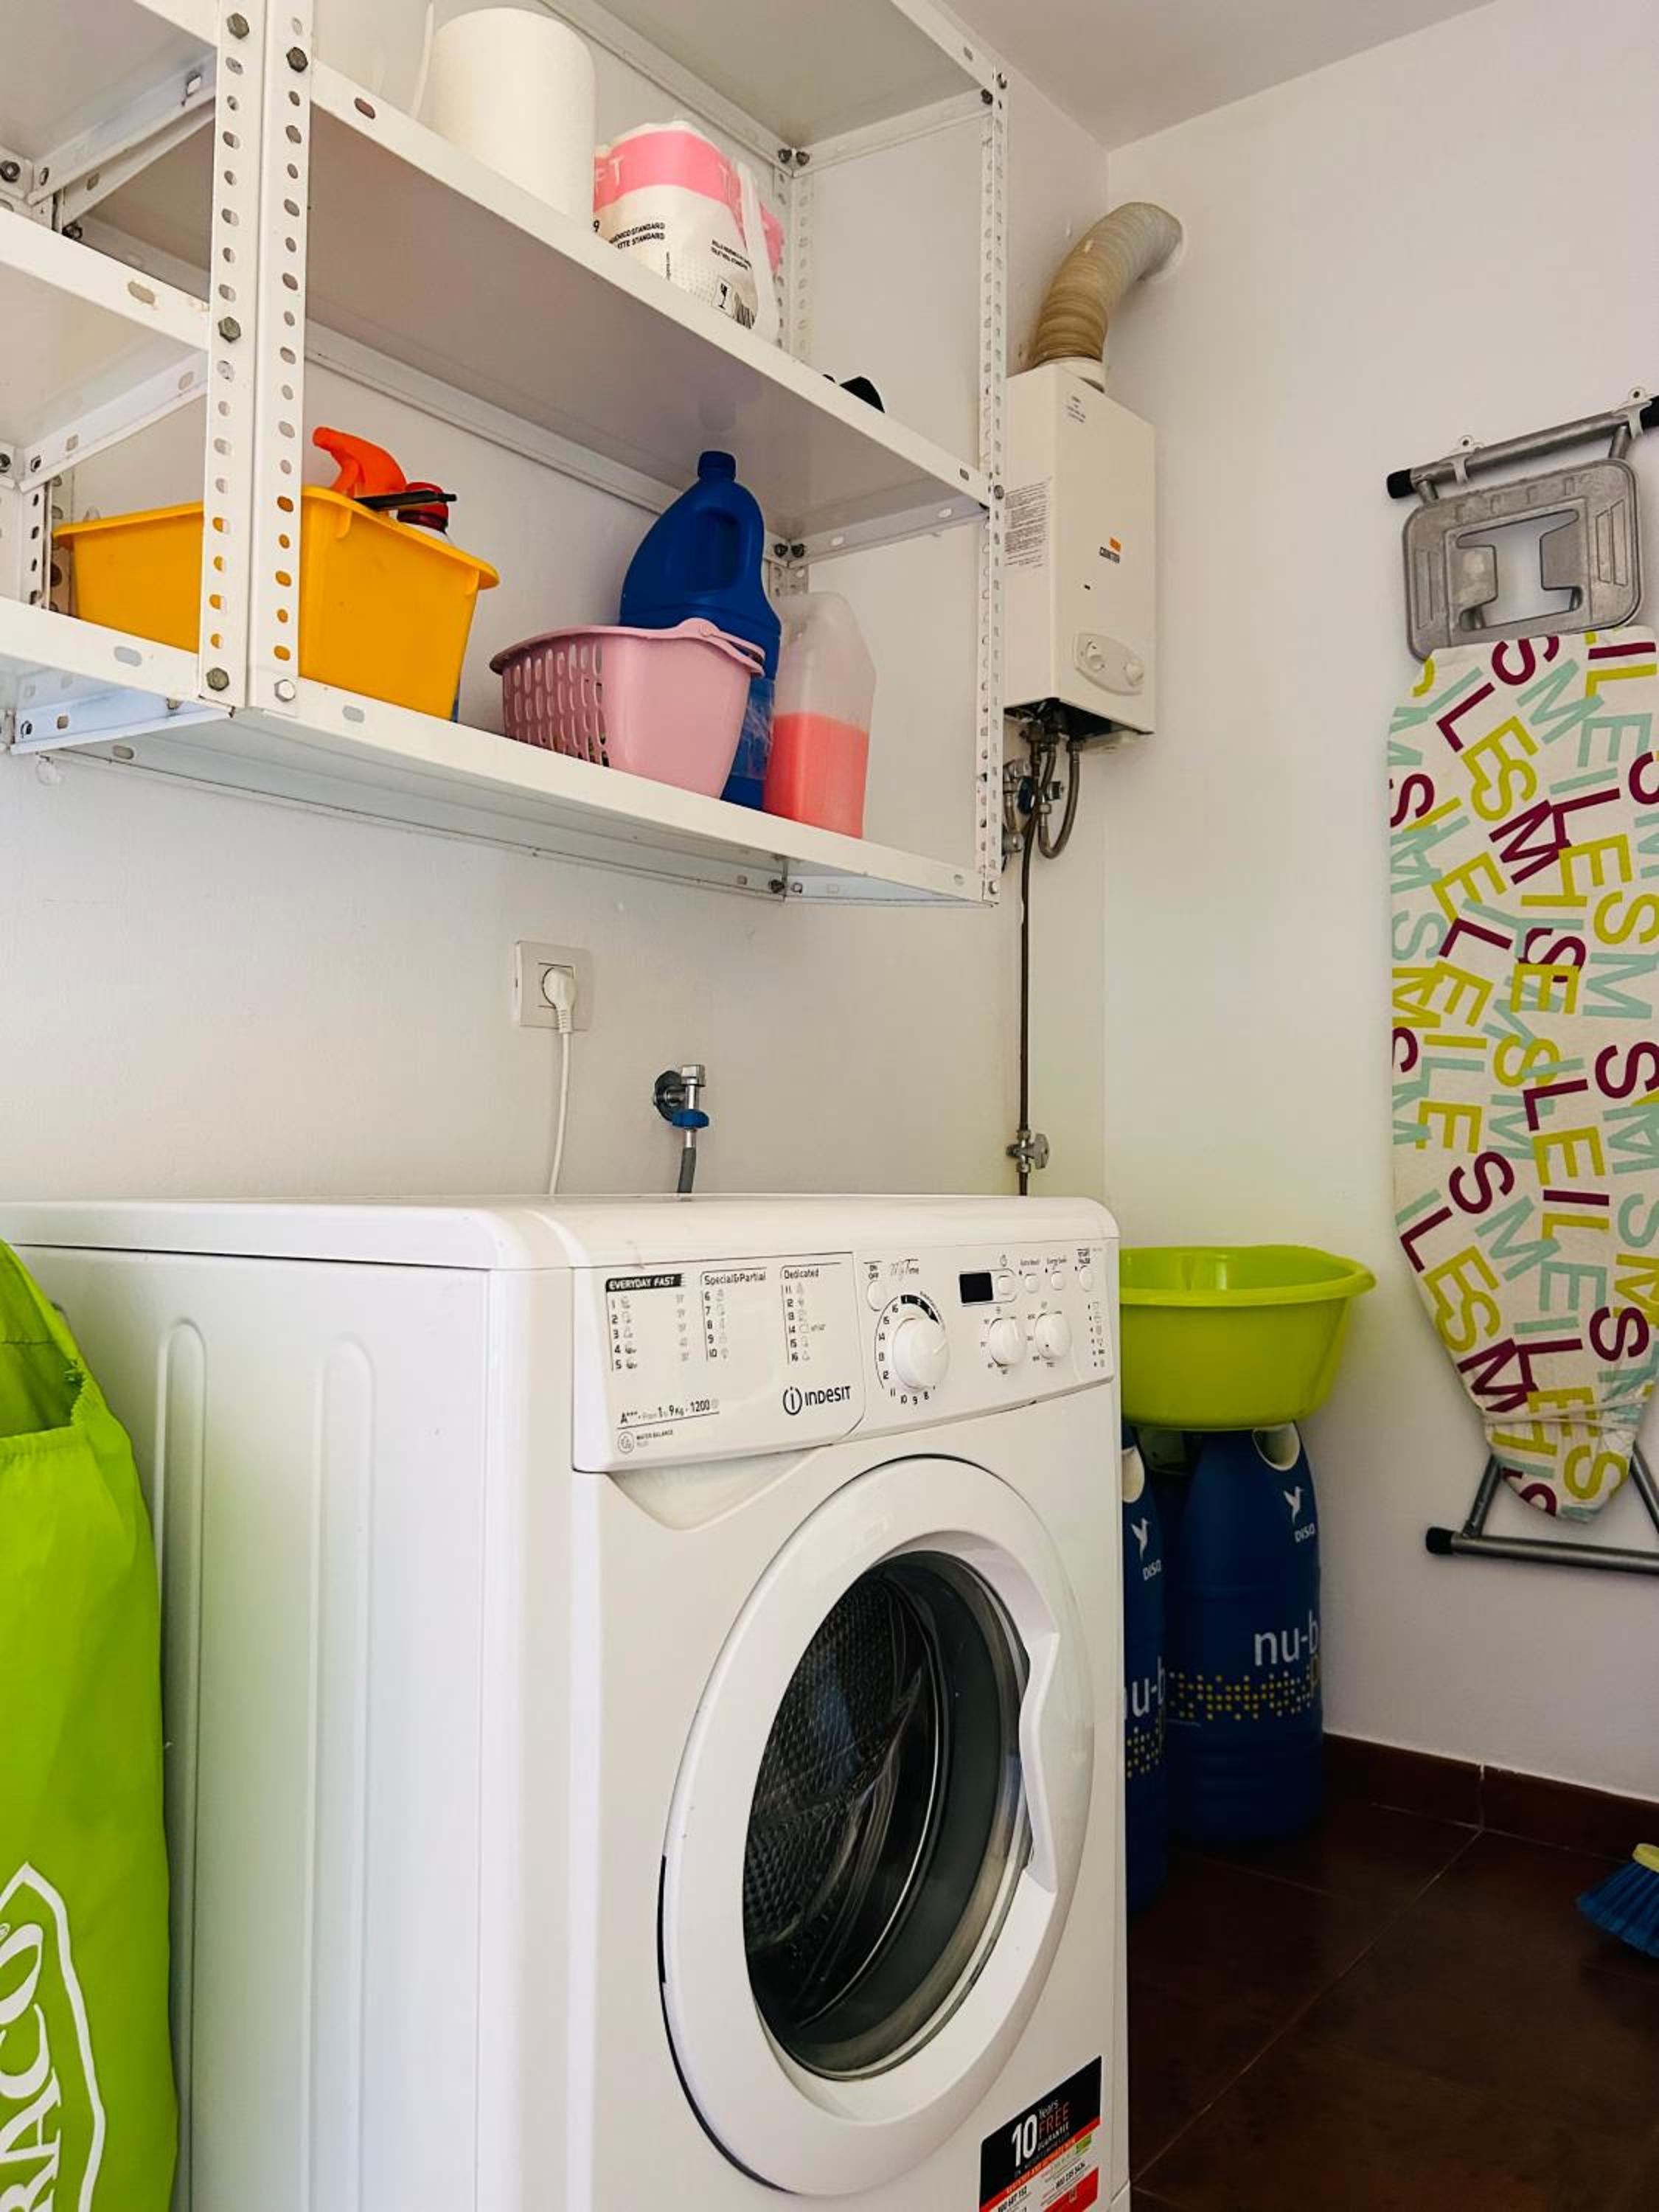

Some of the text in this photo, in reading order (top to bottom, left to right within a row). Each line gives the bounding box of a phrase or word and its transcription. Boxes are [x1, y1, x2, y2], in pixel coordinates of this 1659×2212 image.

[784, 1268, 818, 1279] Dedicated
[608, 1276, 675, 1291] EVERYDAY FAST
[891, 1304, 899, 1314] 16
[883, 1316, 890, 1325] 15
[878, 1332, 886, 1341] 14
[883, 1370, 889, 1380] 12
[890, 1387, 896, 1398] 11
[900, 1394, 908, 1405] 10
[691, 1399, 711, 1413] 1200
[1038, 2101, 1070, 2140] FREE
[1011, 2113, 1037, 2168] 10
